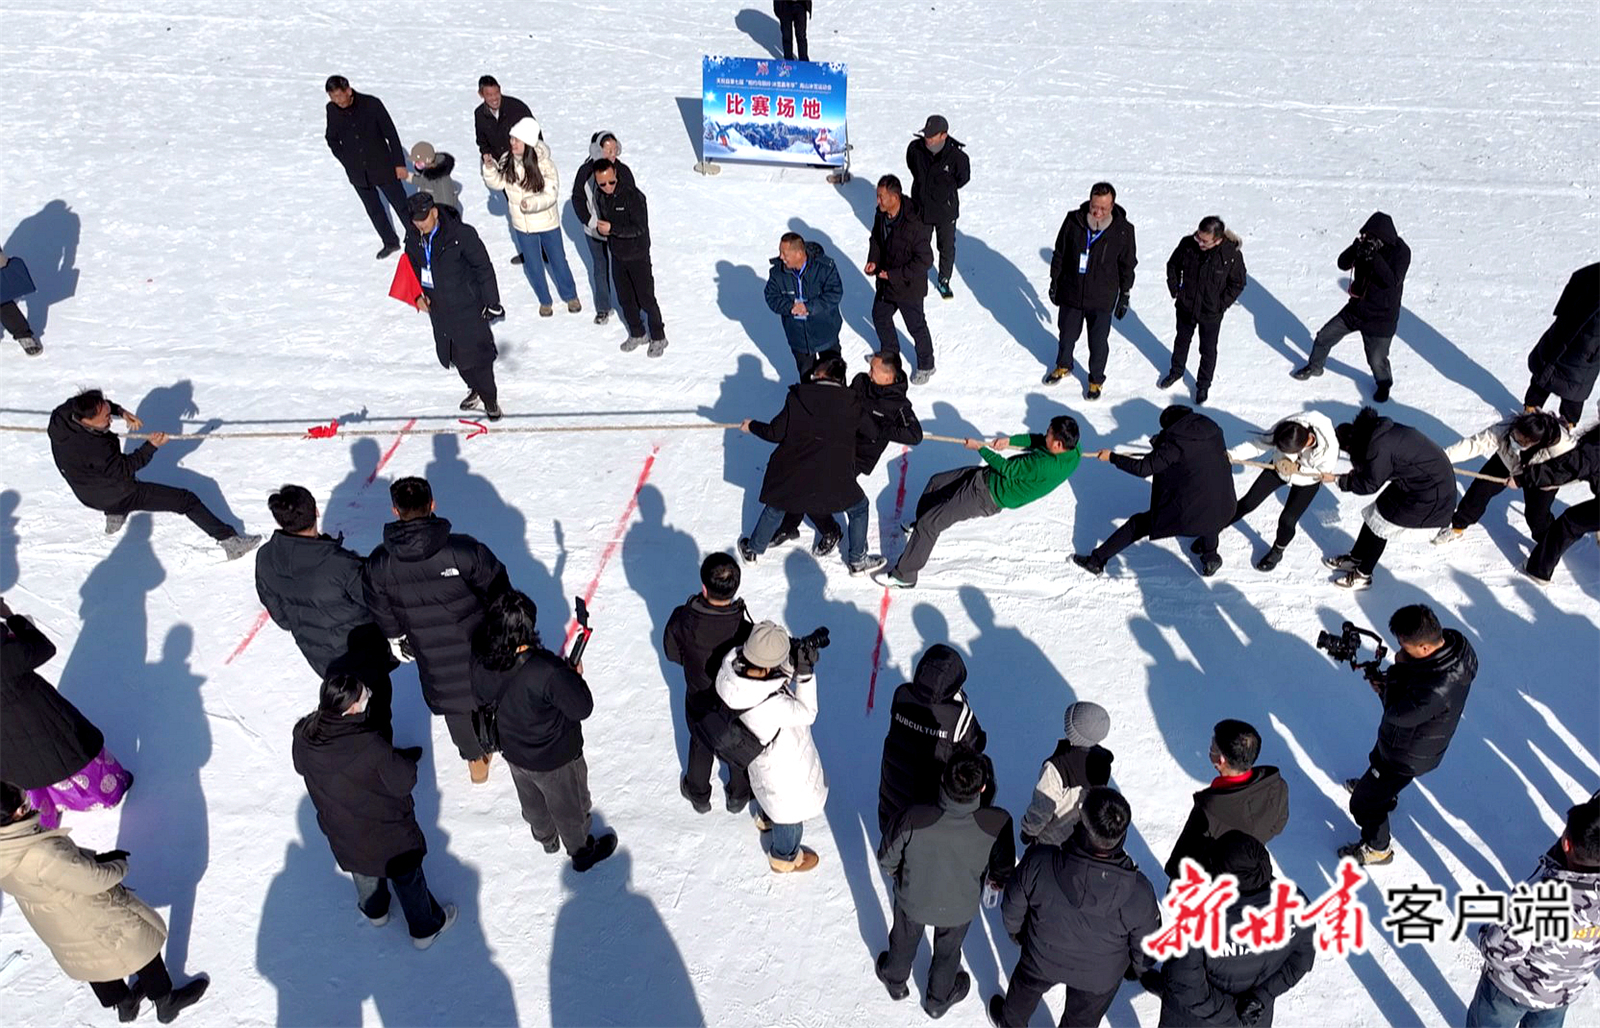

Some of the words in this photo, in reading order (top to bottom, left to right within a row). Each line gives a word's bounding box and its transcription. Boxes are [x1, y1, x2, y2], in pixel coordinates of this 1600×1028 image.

[726, 93, 821, 119] 比赛场地
[895, 712, 948, 739] SUBCULTURE
